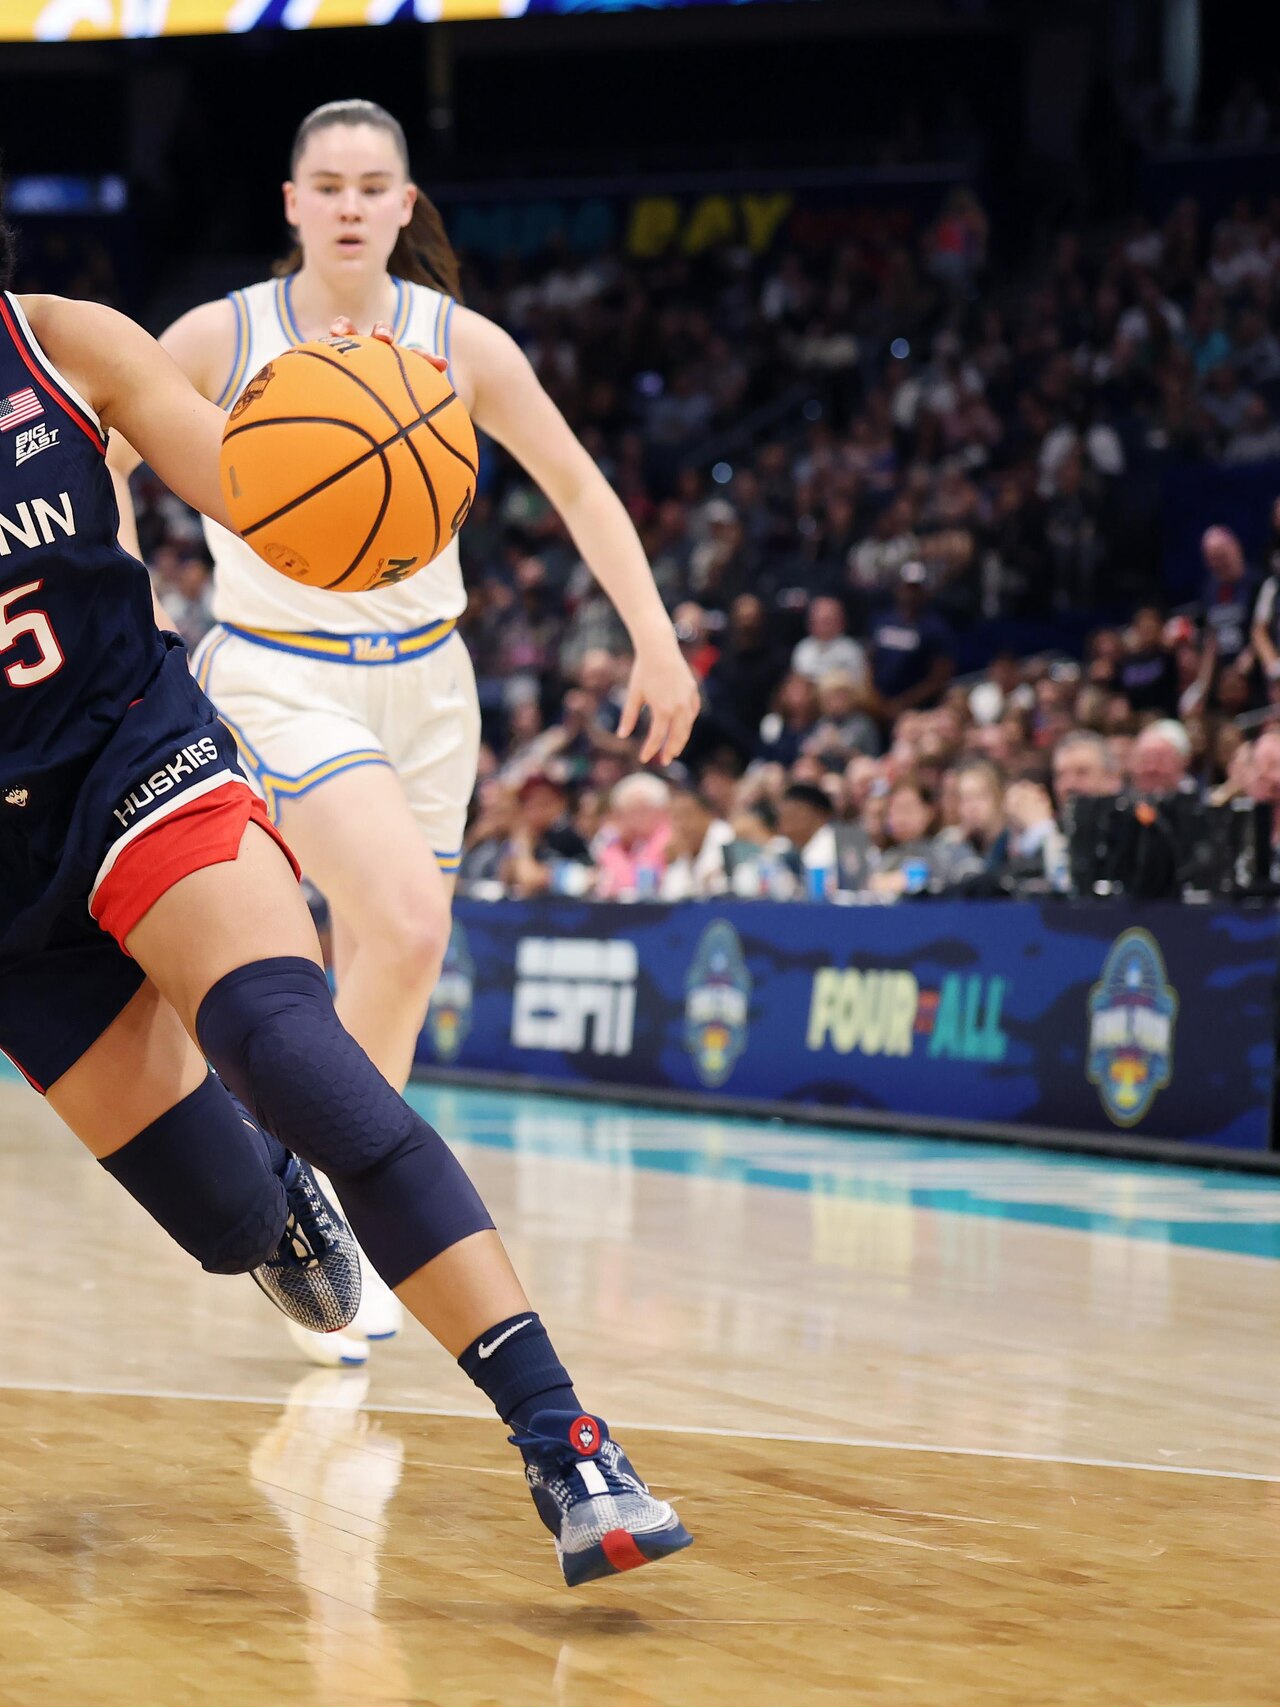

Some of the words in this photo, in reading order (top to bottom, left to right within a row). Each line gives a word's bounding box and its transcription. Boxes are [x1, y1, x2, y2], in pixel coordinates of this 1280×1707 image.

[16, 422, 46, 448] BIG
[16, 428, 59, 460] EAST
[113, 737, 218, 828] HUSKIES
[511, 936, 639, 1056] ESPN
[807, 966, 918, 1057] FOUR
[927, 971, 1009, 1062] ALL
